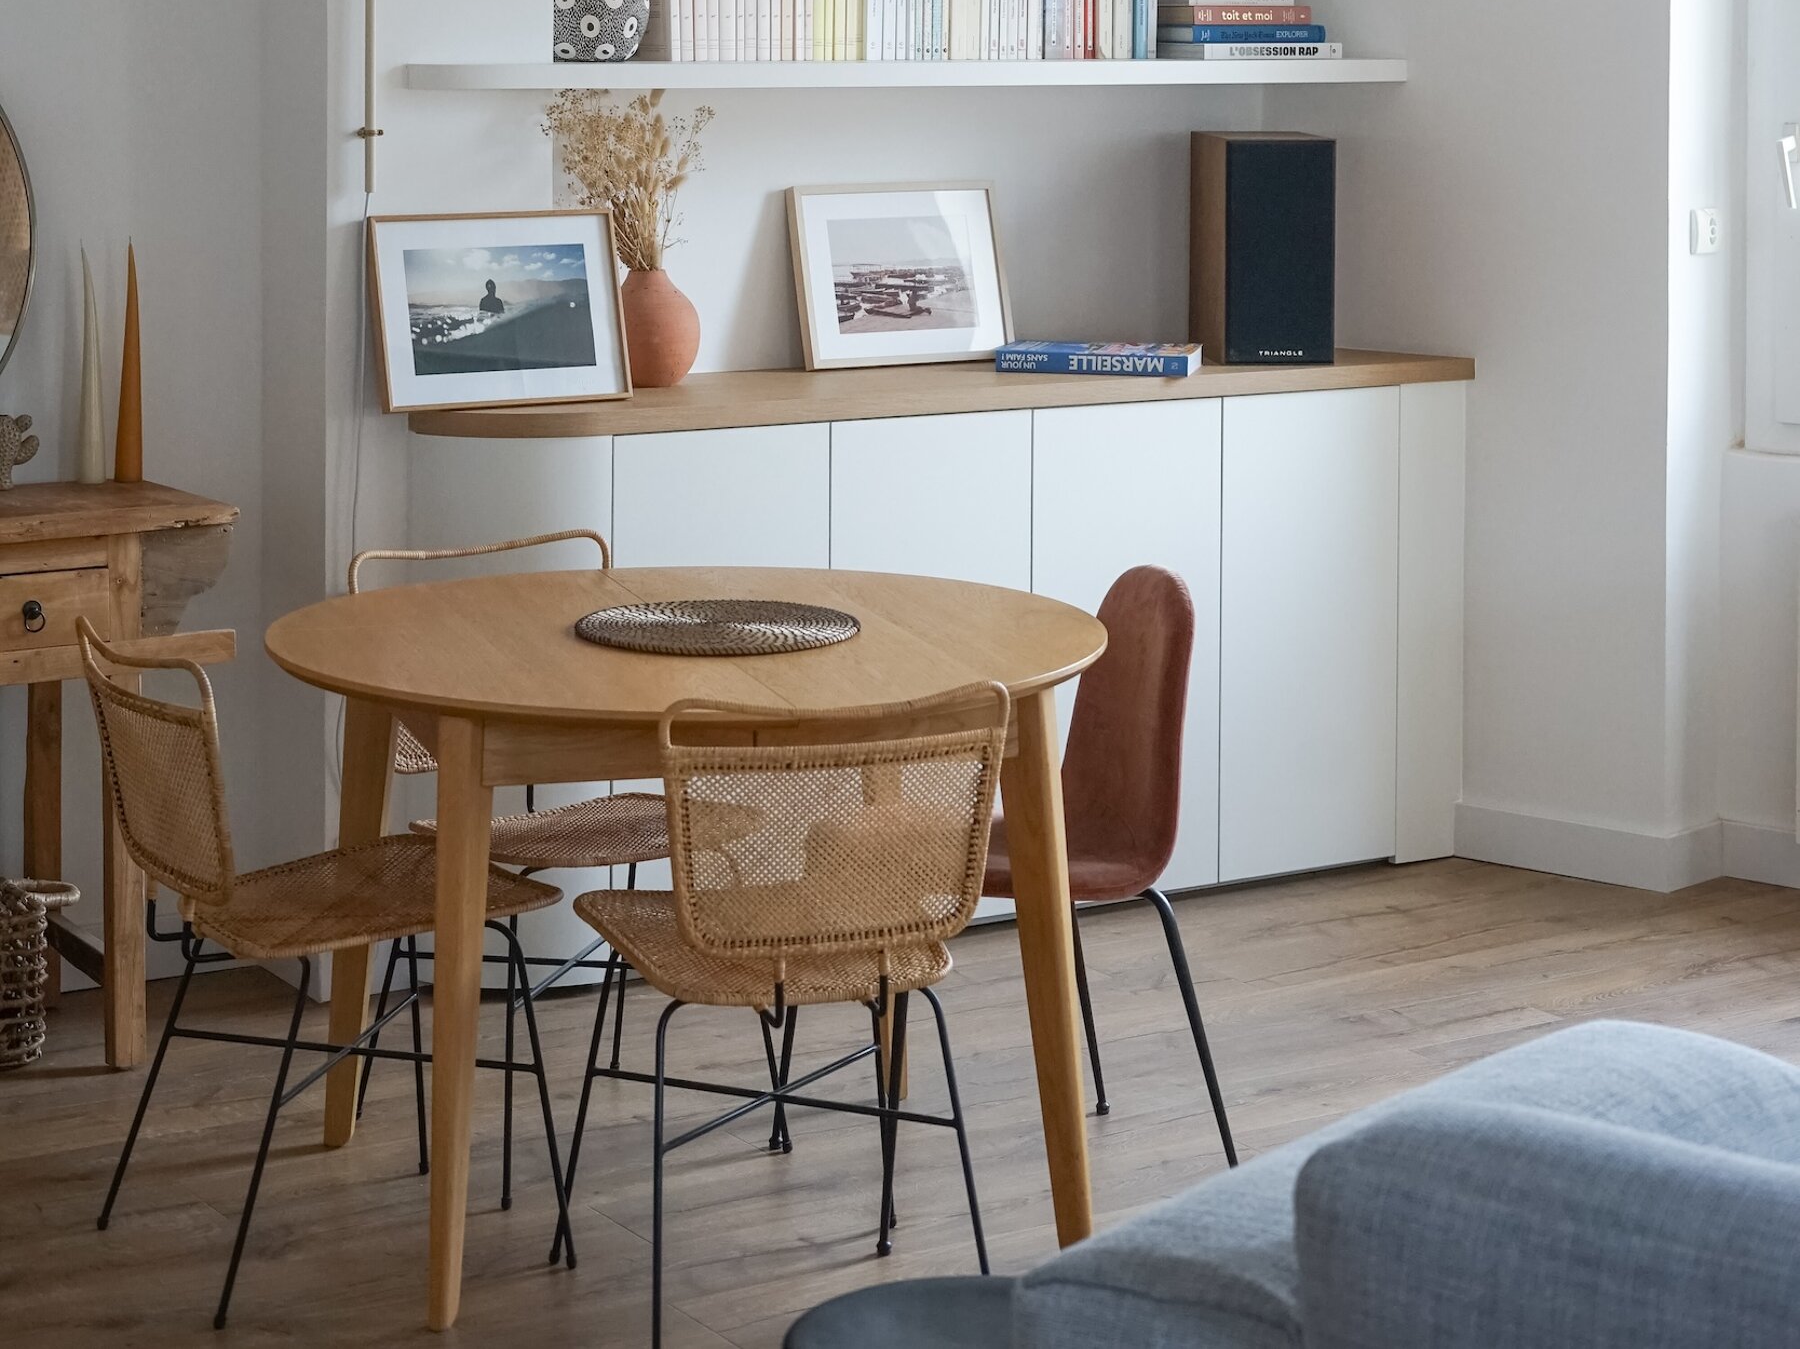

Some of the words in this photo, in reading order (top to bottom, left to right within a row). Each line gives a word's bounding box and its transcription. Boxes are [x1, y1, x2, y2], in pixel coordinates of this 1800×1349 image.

[1221, 10, 1240, 21] toit
[1242, 10, 1252, 21] et
[1255, 10, 1273, 21] moi
[1276, 30, 1309, 38] EXPLORER
[1229, 46, 1297, 56] L'OBSESSION
[1298, 46, 1319, 56] RAP
[1007, 354, 1026, 362] FAIM
[1026, 354, 1048, 362] SANS
[1000, 360, 1024, 370] JOUR
[1025, 361, 1037, 370] UN
[1068, 355, 1165, 374] MARSEILLE
